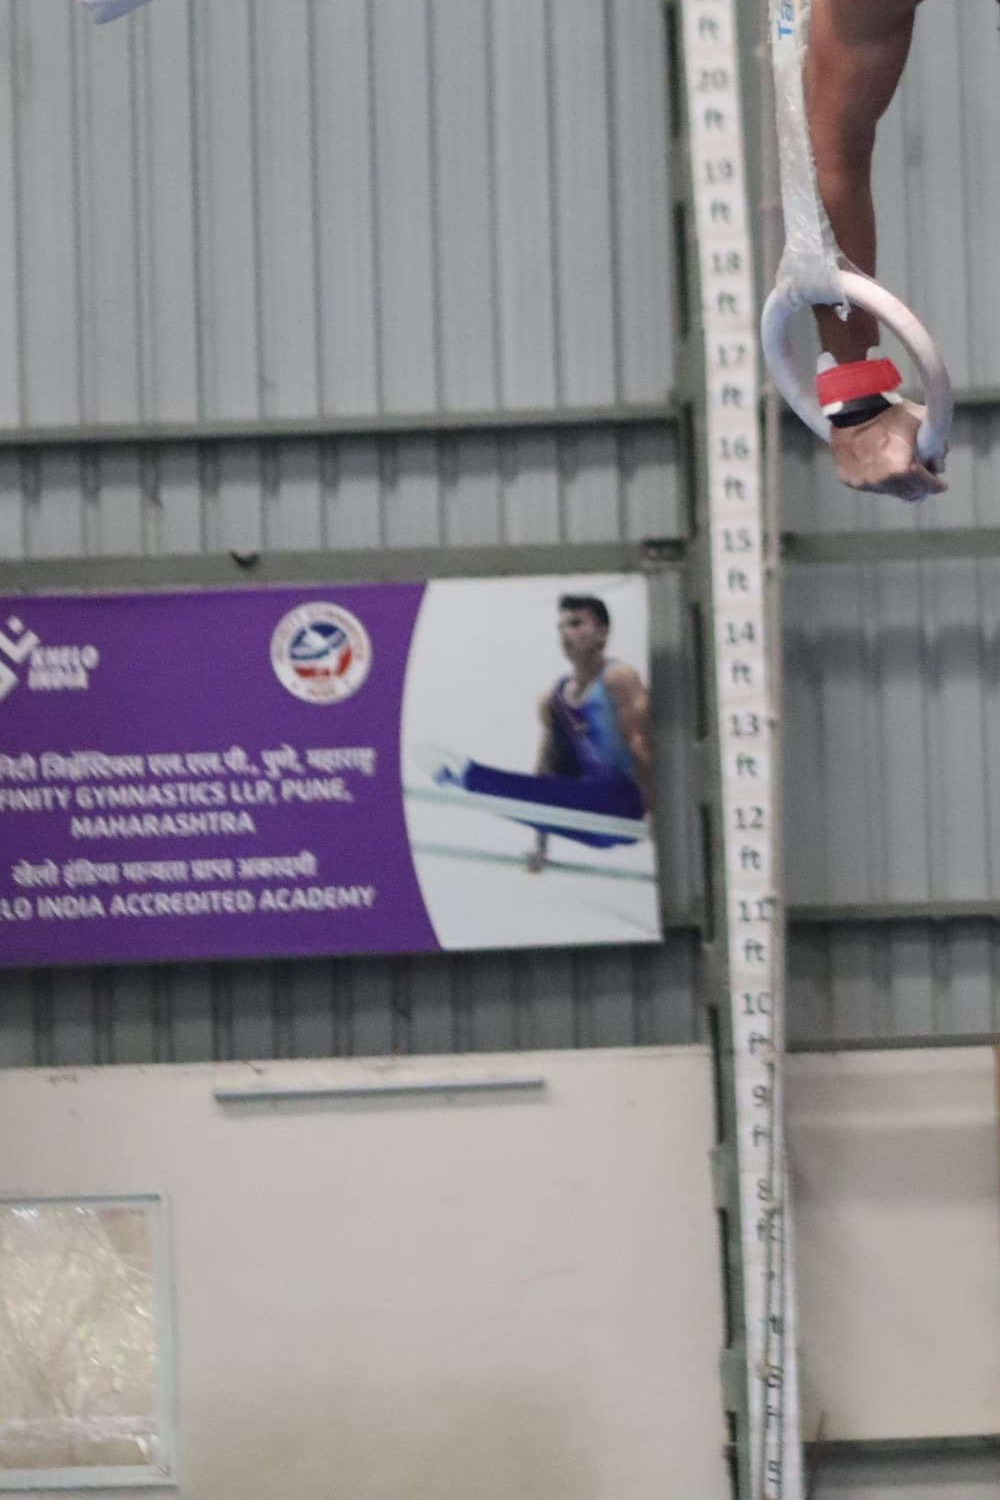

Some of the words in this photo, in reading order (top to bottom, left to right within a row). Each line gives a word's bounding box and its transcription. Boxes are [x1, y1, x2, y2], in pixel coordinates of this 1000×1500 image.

[721, 529, 751, 552] 15
[724, 621, 756, 643] 14
[730, 660, 752, 684] ft
[729, 714, 760, 737] 13
[735, 753, 757, 777] ft
[75, 780, 227, 810] GYMNASTICS
[70, 811, 256, 840] MAHARASHTRA
[733, 806, 763, 829] 12
[739, 846, 761, 870] ft
[37, 894, 106, 919] INDIA
[110, 890, 256, 917] ACCREDITED
[258, 885, 376, 913] ACADEMY
[744, 938, 766, 962] ft
